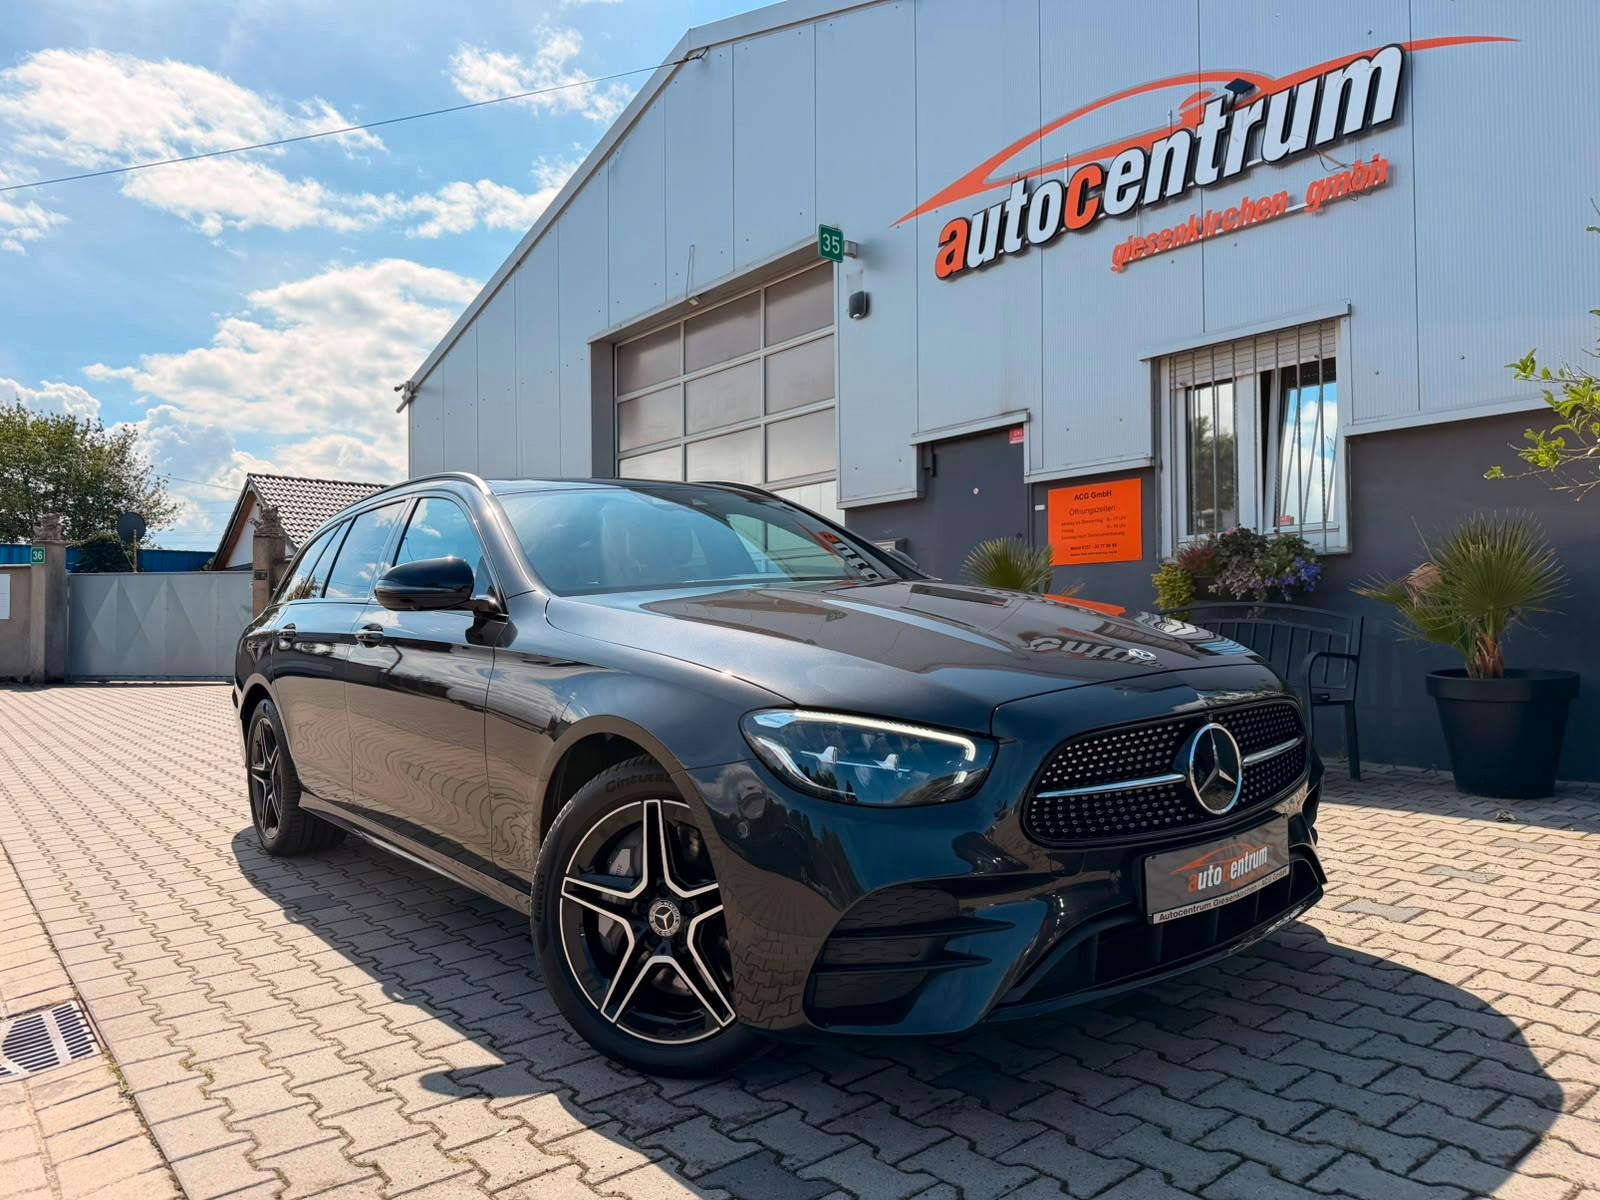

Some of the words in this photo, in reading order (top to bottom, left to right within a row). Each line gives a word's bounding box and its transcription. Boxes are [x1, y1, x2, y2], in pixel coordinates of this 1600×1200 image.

[935, 43, 1406, 280] autocentrum
[1111, 190, 1289, 272] giesenkirchen
[822, 233, 840, 254] 35
[1074, 492, 1089, 501] ACG
[1091, 490, 1112, 499] GmbH
[32, 551, 43, 560] 36
[1159, 901, 1212, 921] Autocentrum
